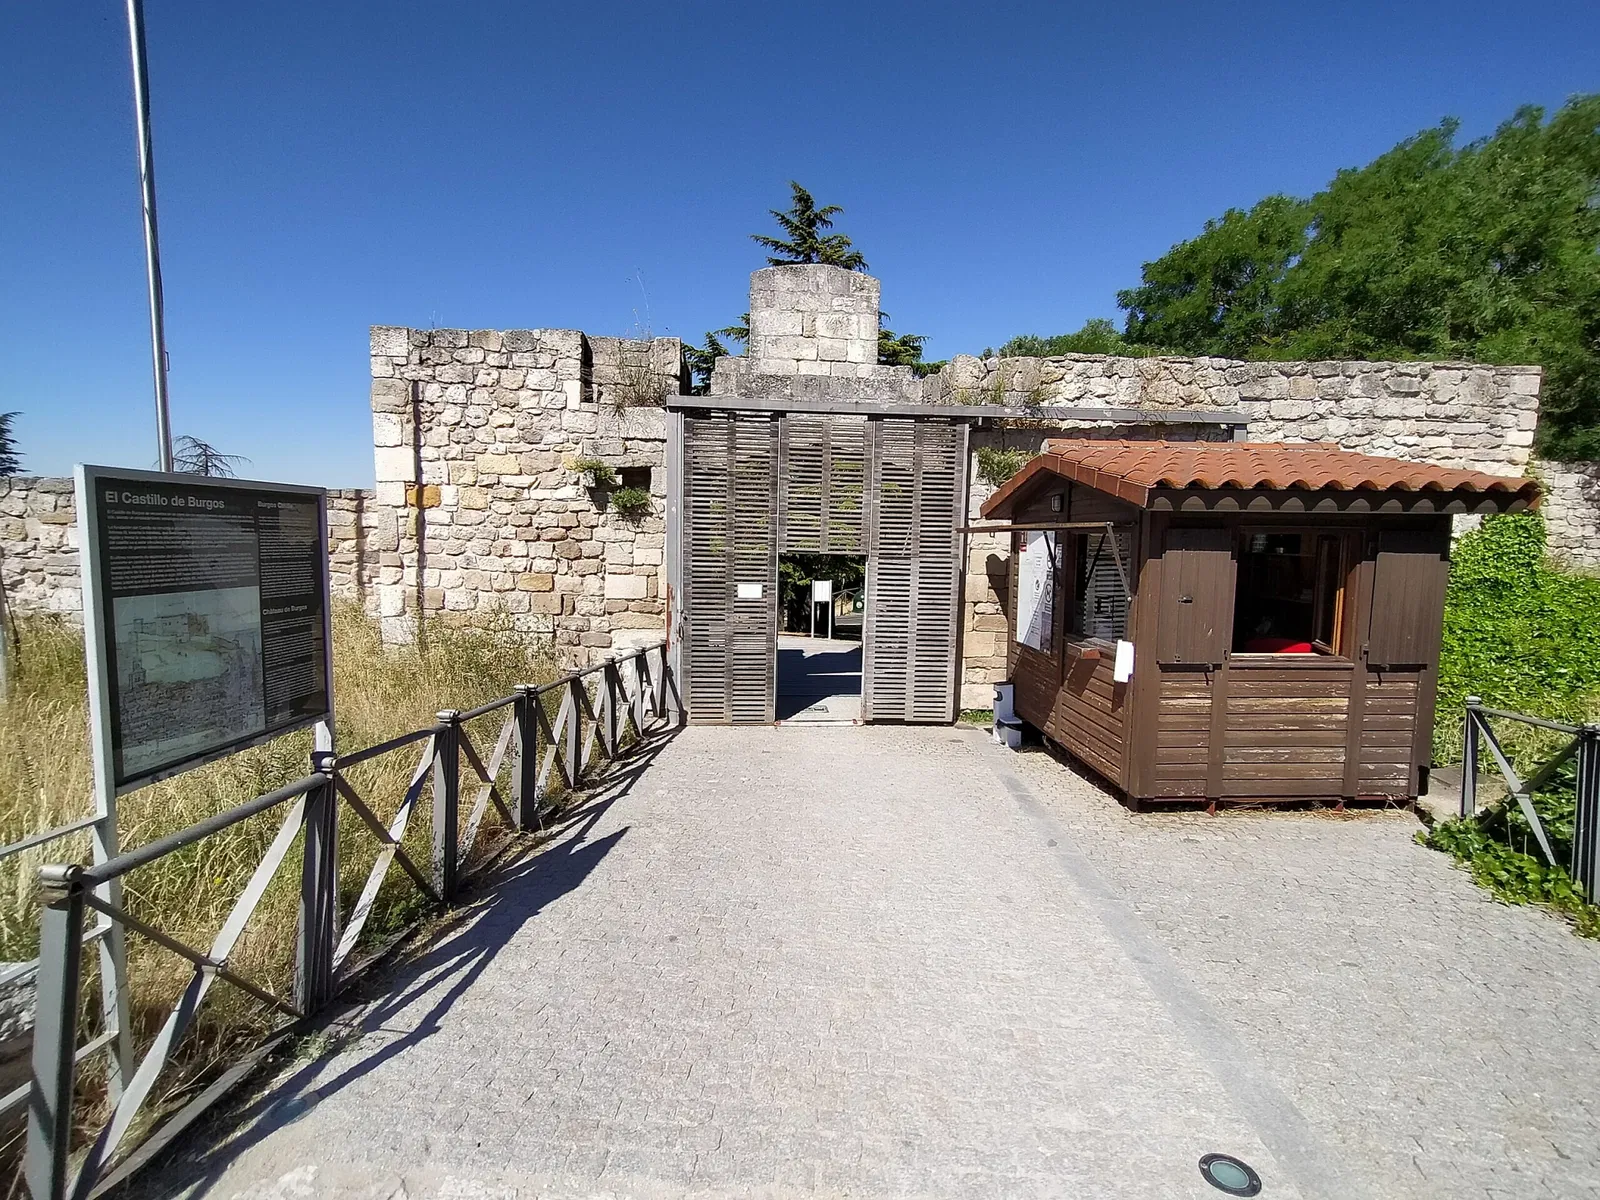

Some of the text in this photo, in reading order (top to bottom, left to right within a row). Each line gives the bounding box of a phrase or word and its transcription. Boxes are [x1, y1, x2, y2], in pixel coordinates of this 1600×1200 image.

[105, 491, 225, 510] El Castillo de Burgos
